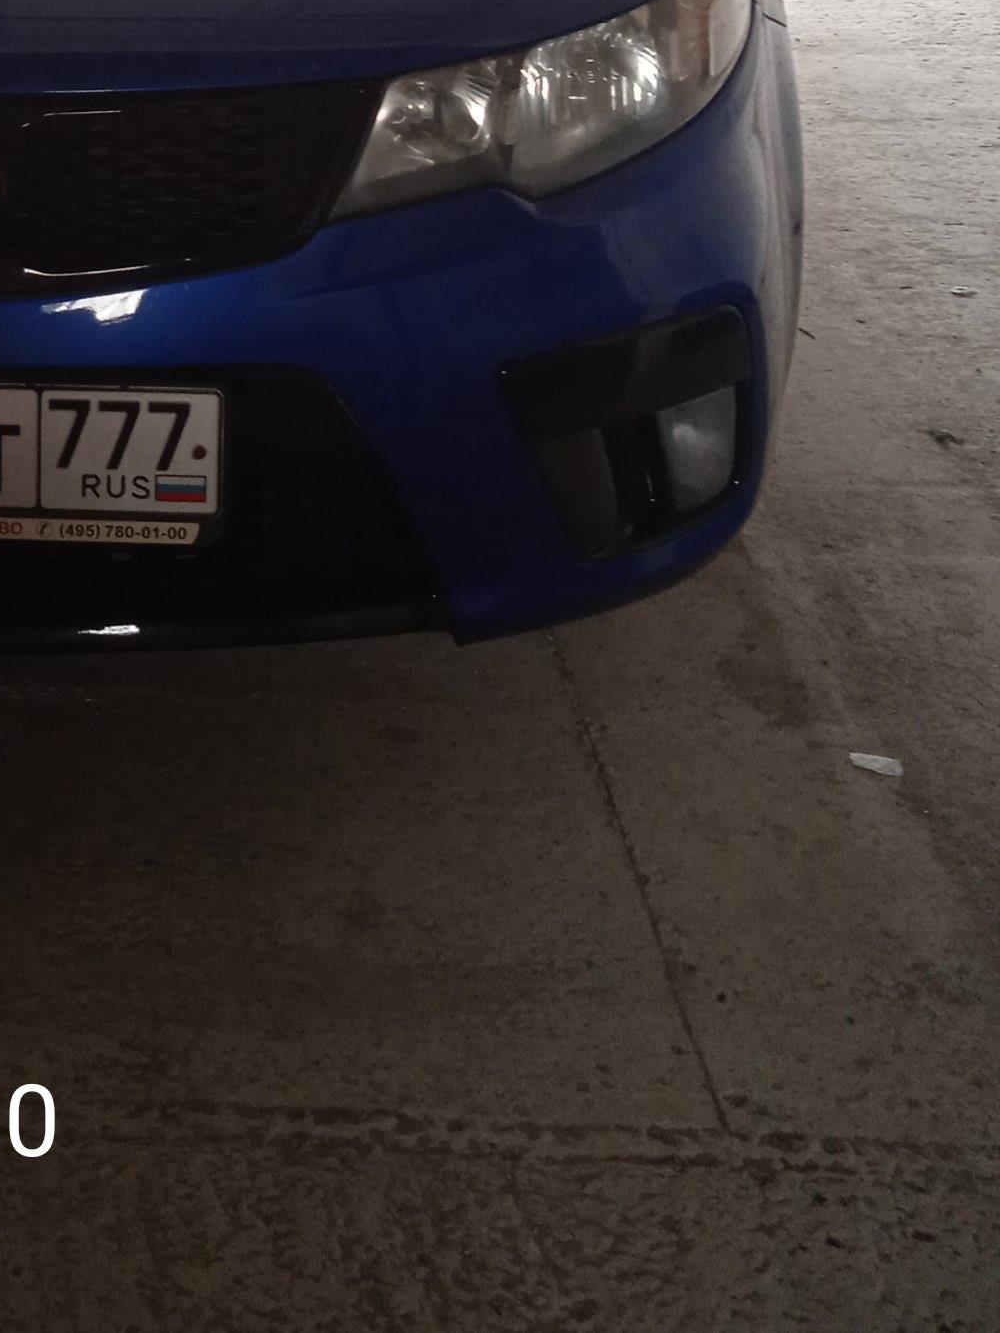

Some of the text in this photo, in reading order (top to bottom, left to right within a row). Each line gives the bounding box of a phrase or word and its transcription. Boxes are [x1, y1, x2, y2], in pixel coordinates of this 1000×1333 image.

[49, 399, 192, 471] 777
[81, 474, 150, 500] RUS
[60, 523, 100, 540] (495)
[106, 524, 188, 540] 780-01-00
